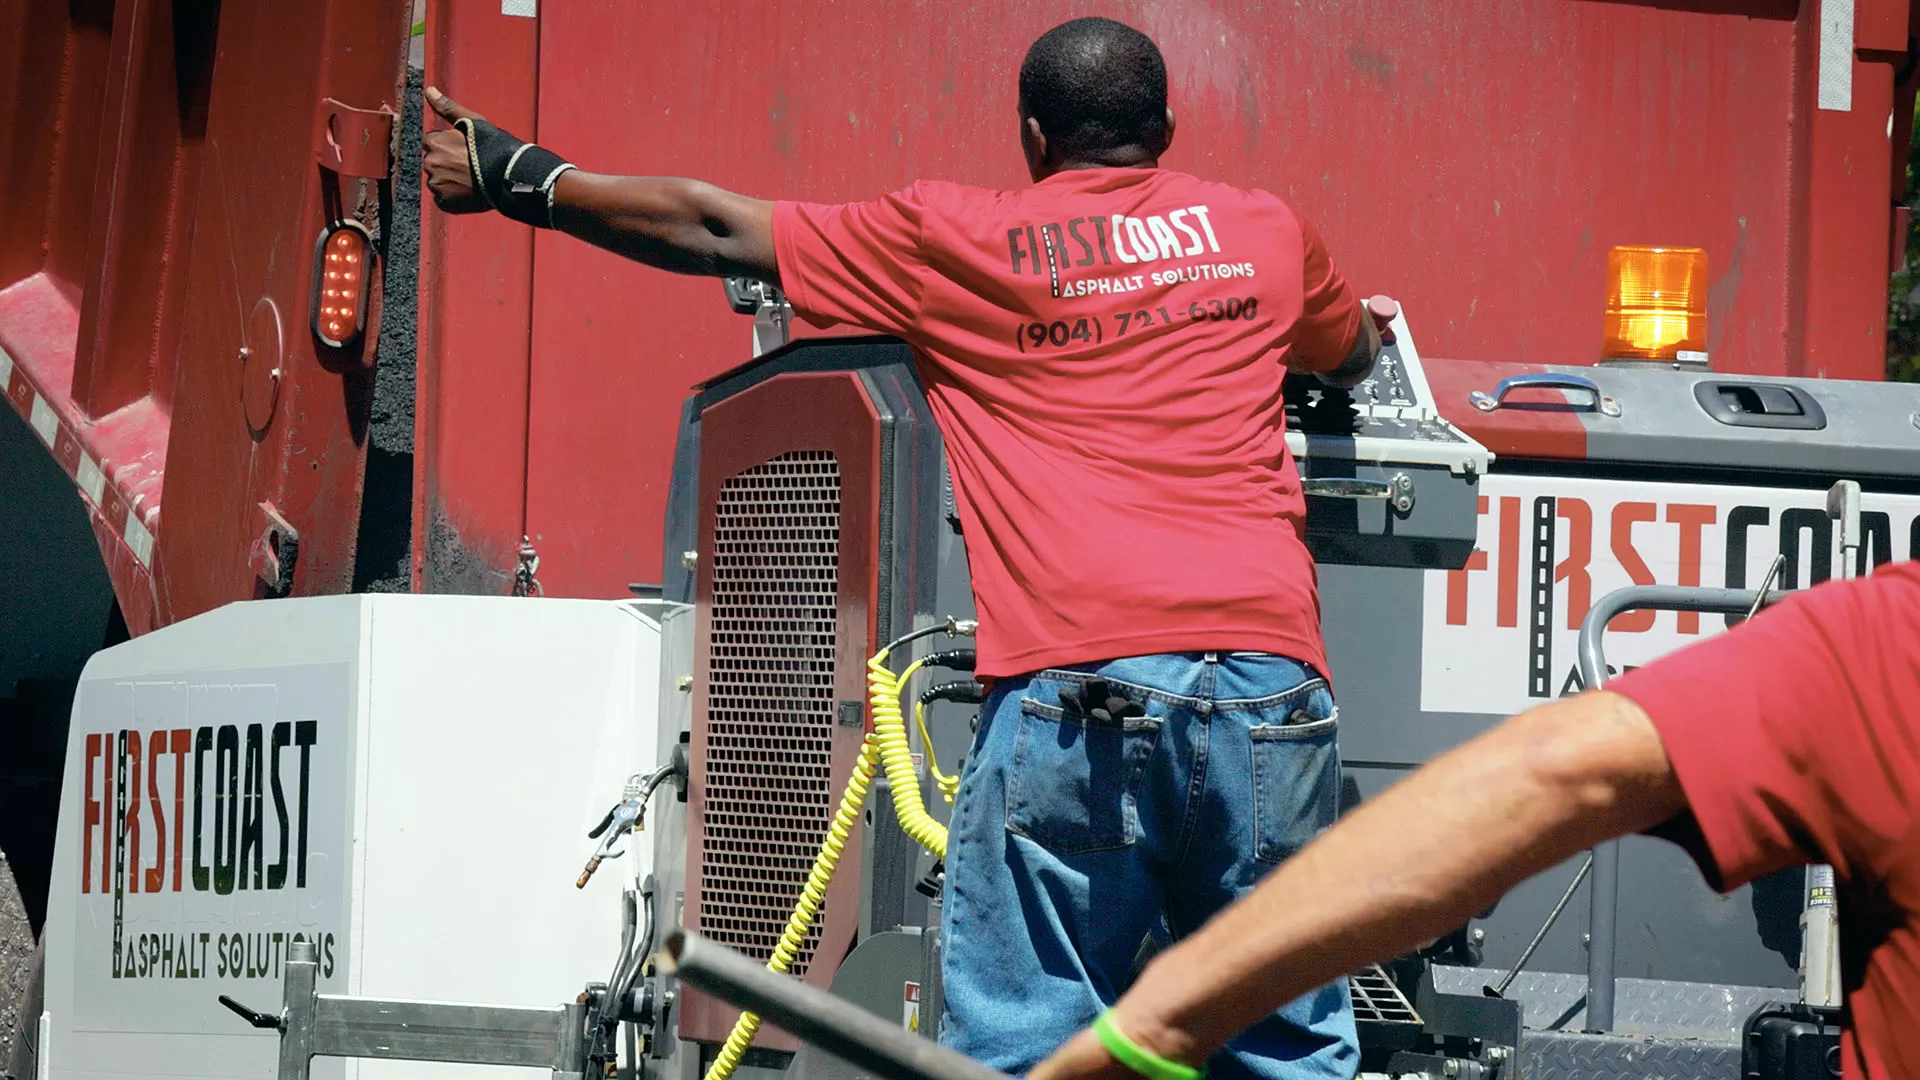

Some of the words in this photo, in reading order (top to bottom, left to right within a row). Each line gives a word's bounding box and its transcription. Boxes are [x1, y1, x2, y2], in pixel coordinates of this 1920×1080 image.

[1062, 275, 1145, 298] ASPHALT
[1151, 262, 1256, 287] SOLUTIONS
[1016, 316, 1103, 353] (904)
[1113, 296, 1259, 337] 721-6300
[124, 932, 210, 979] ASPHALT
[217, 932, 335, 979] SOLUTINS
